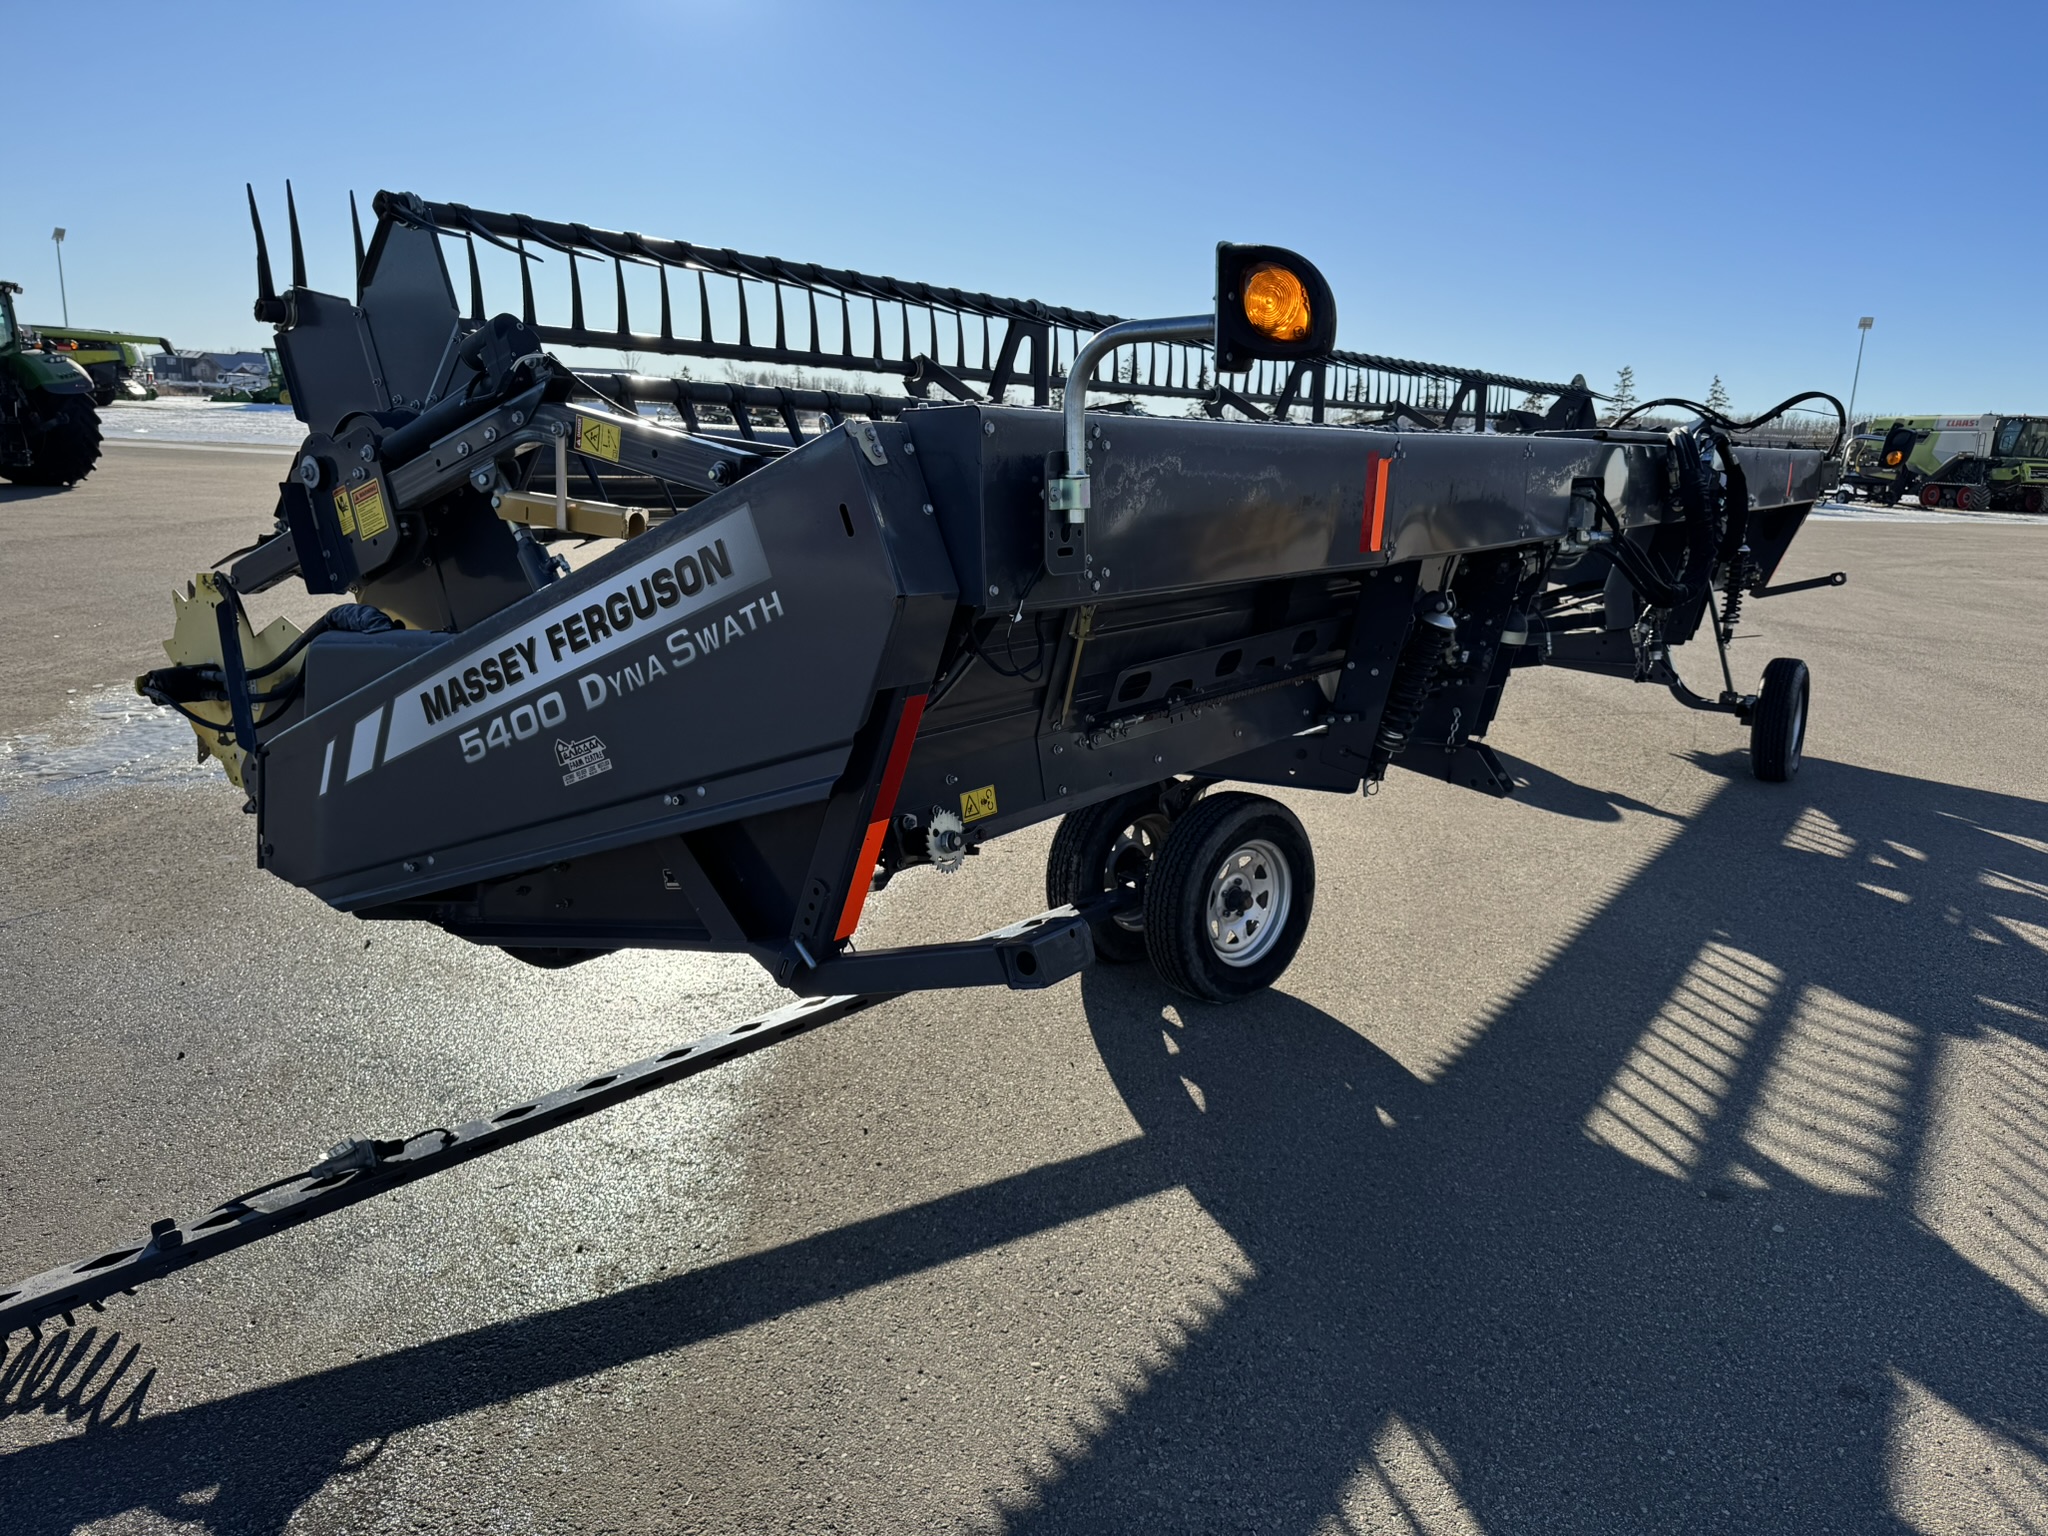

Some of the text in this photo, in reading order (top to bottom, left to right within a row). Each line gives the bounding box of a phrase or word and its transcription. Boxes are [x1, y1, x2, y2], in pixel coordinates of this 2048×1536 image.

[1946, 419, 1975, 427] CLAAS
[420, 538, 734, 726] MASSEY FERGUSON
[458, 690, 568, 764] 5400
